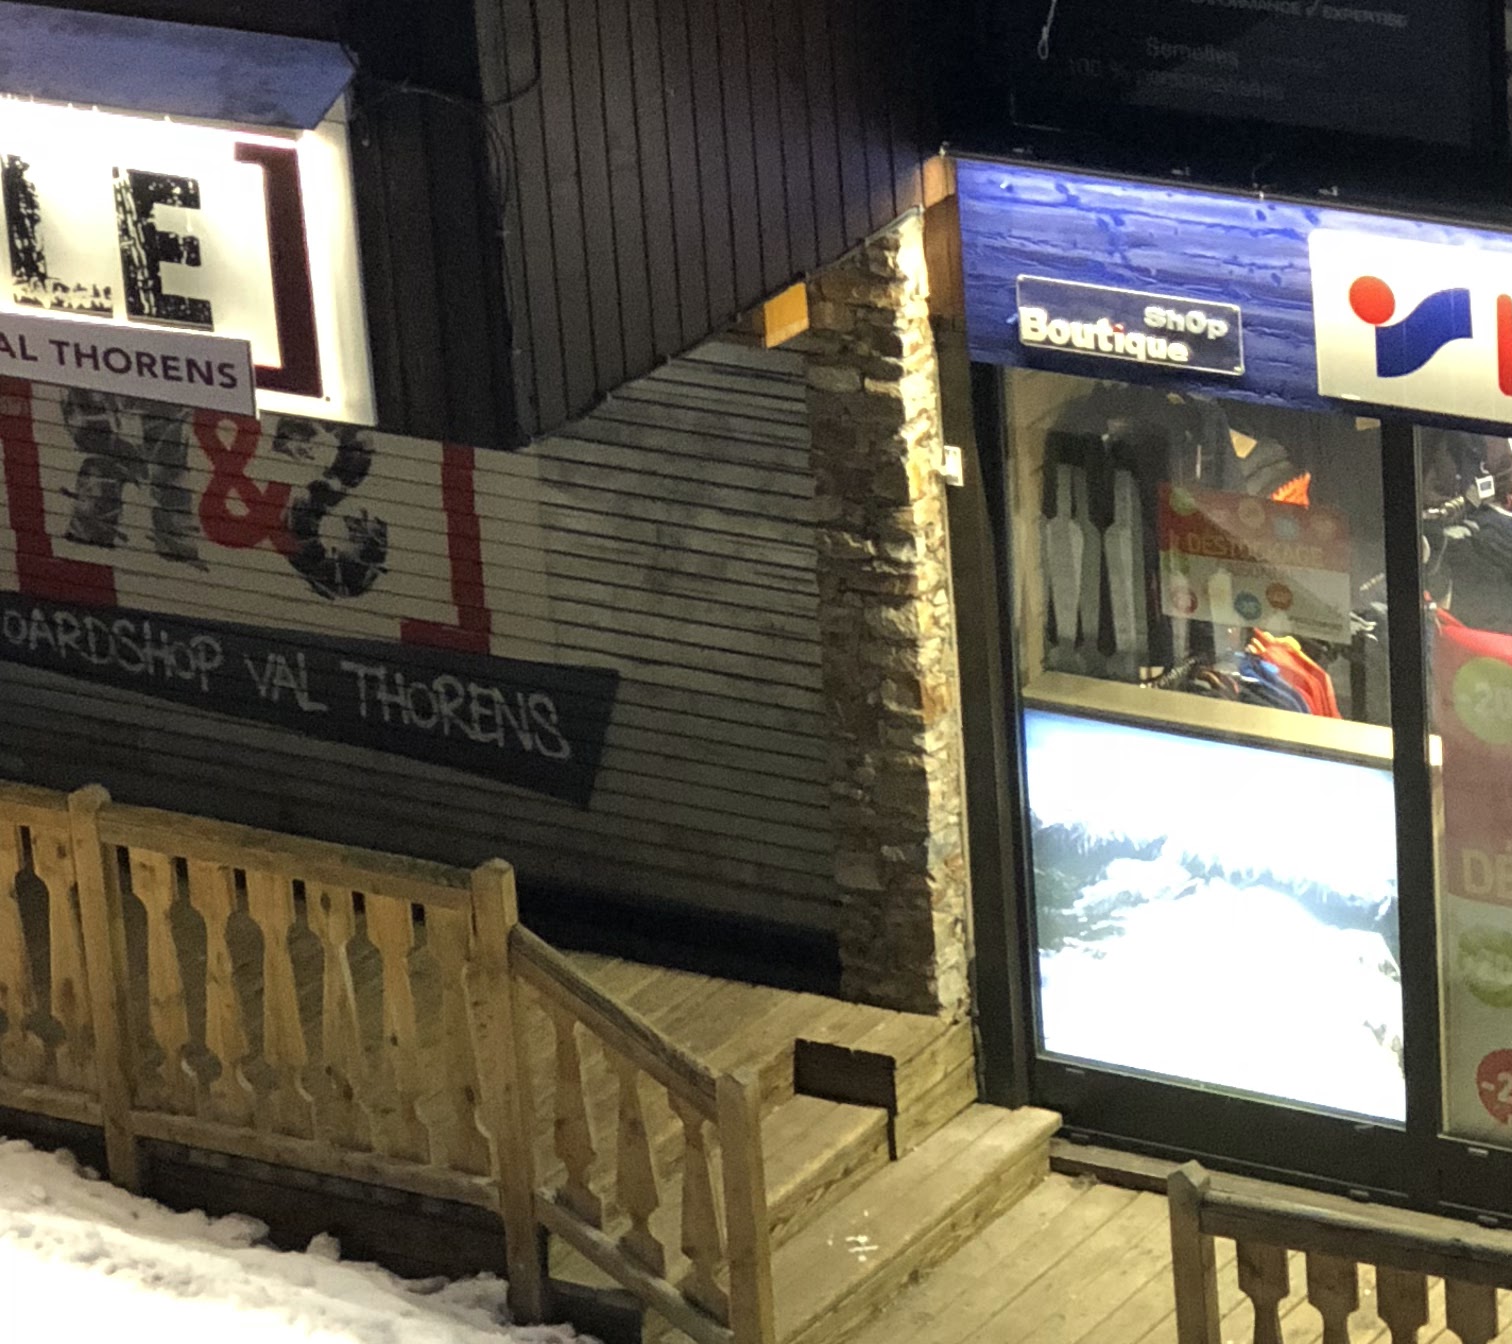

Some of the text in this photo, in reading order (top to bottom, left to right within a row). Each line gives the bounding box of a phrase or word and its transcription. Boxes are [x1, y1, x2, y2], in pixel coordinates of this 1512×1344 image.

[1018, 306, 1190, 363] Boutique
[49, 339, 239, 389] THORENS
[244, 652, 327, 713] VAL
[341, 659, 572, 761] THORENS
